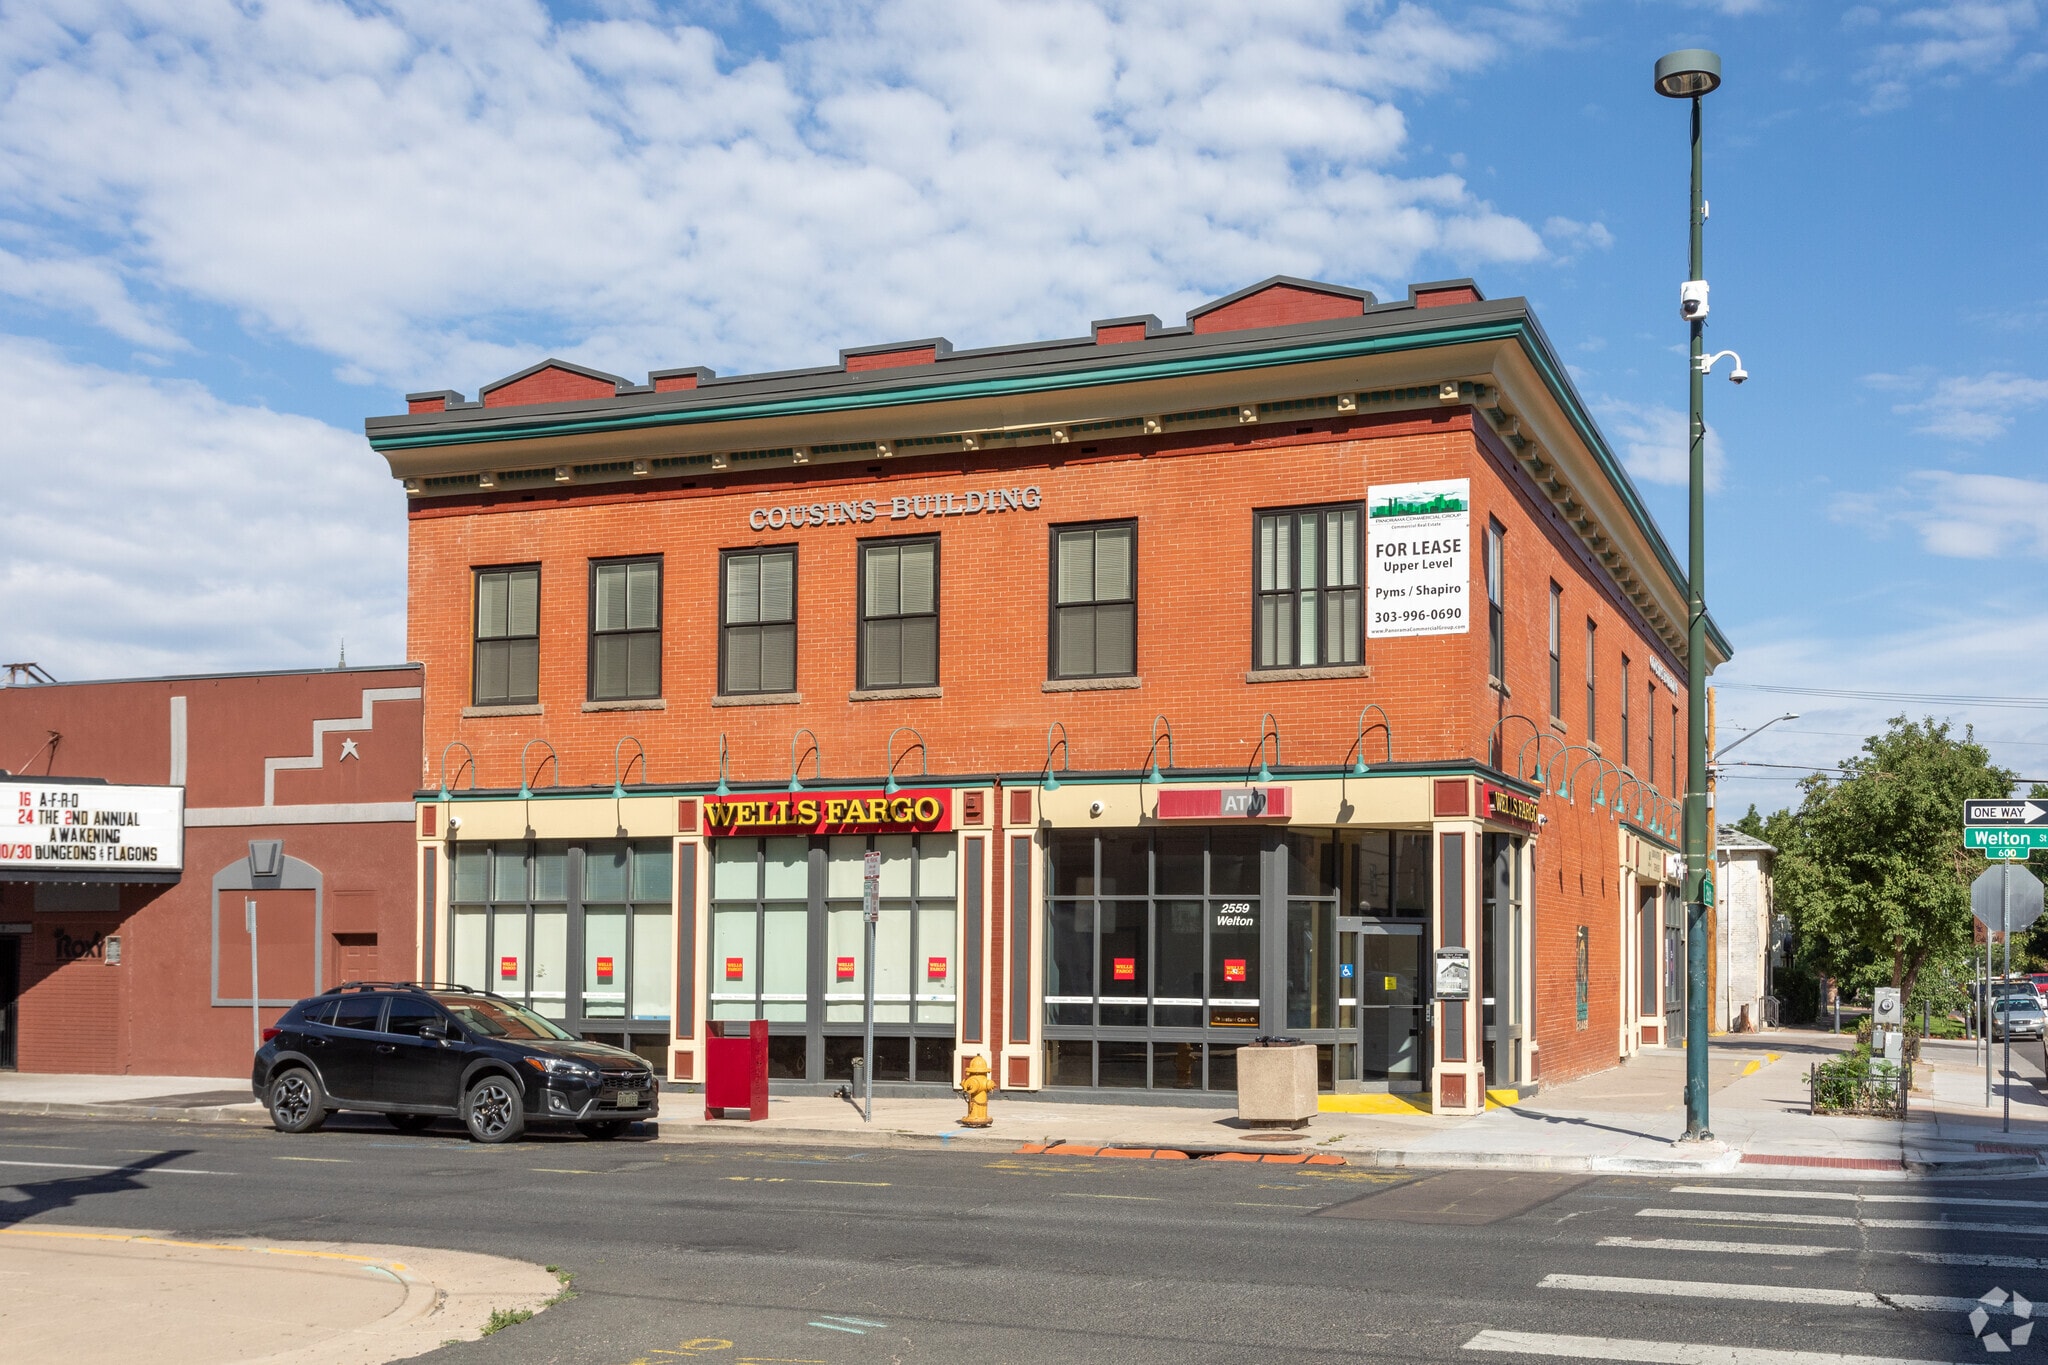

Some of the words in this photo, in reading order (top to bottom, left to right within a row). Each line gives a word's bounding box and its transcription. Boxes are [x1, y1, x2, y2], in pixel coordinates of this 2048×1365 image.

[750, 499, 877, 530] COUSINS
[891, 486, 1042, 519] BUILDING
[1376, 542, 1407, 558] FOR
[1413, 538, 1461, 555] LEASE
[1384, 561, 1419, 574] Upper
[1422, 557, 1453, 570] Level
[1375, 587, 1406, 600] Pyms
[1408, 585, 1413, 596] /
[1416, 583, 1461, 597] Shapiro
[1375, 607, 1462, 623] 303-996-0690
[1371, 624, 1466, 634] www.PanoramaCommercialGroup.com
[19, 791, 31, 806] 16
[40, 792, 79, 808] A-F-R-O
[1224, 795, 1264, 811] ATM
[18, 809, 33, 824] 24
[38, 809, 59, 825] THE
[65, 810, 88, 825] 2ND
[93, 811, 140, 827] ANNUAL
[704, 799, 820, 826] WELLS
[825, 796, 941, 824] FARGO
[1974, 807, 1997, 818] ONE
[2001, 807, 2025, 818] WAY
[1974, 831, 2031, 845] Welton
[2039, 834, 2047, 842] St
[35, 845, 96, 860] DUNGEONS
[107, 846, 158, 861] FLAGONS
[1998, 849, 2017, 857] 600
[1220, 903, 1250, 914] 2559
[1217, 915, 1254, 926] Welton
